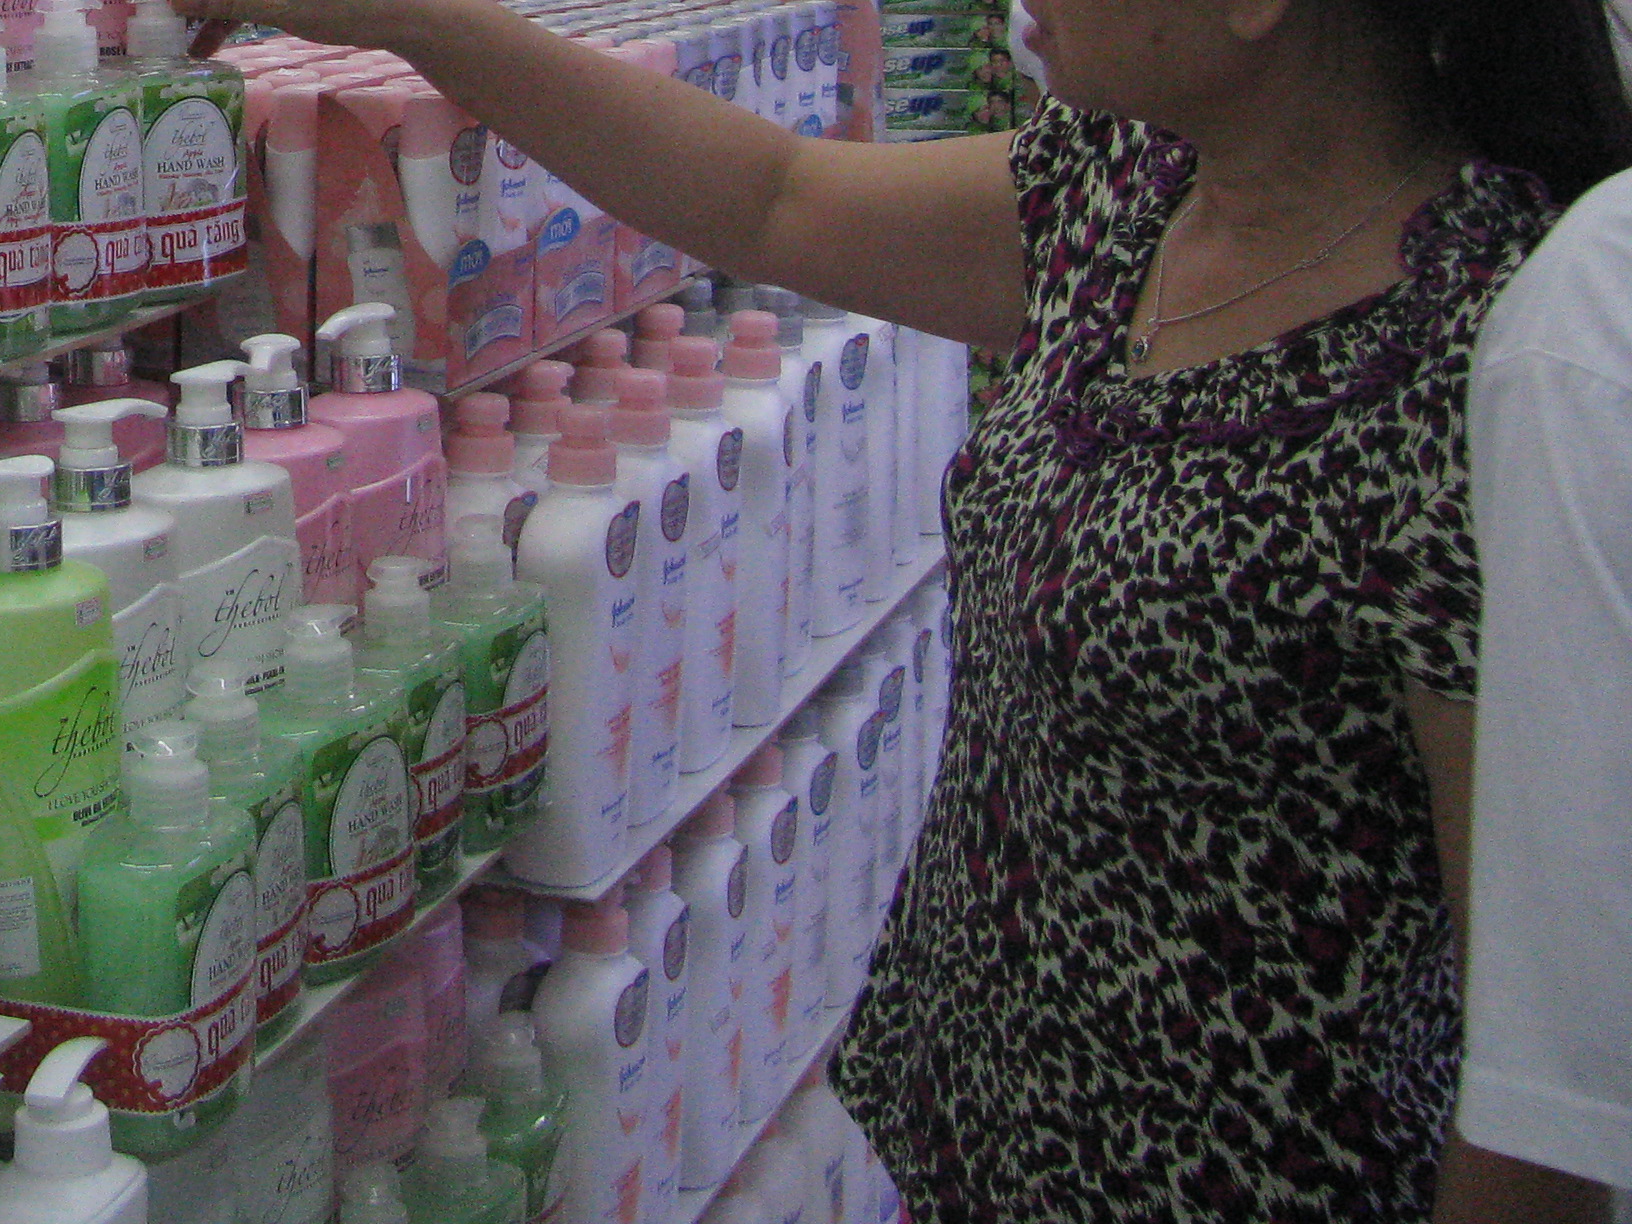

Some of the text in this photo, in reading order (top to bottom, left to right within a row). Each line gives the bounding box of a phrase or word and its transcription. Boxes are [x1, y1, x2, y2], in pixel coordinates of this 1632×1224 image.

[156, 156, 226, 174] HAND WASH
[161, 222, 198, 264] quà
